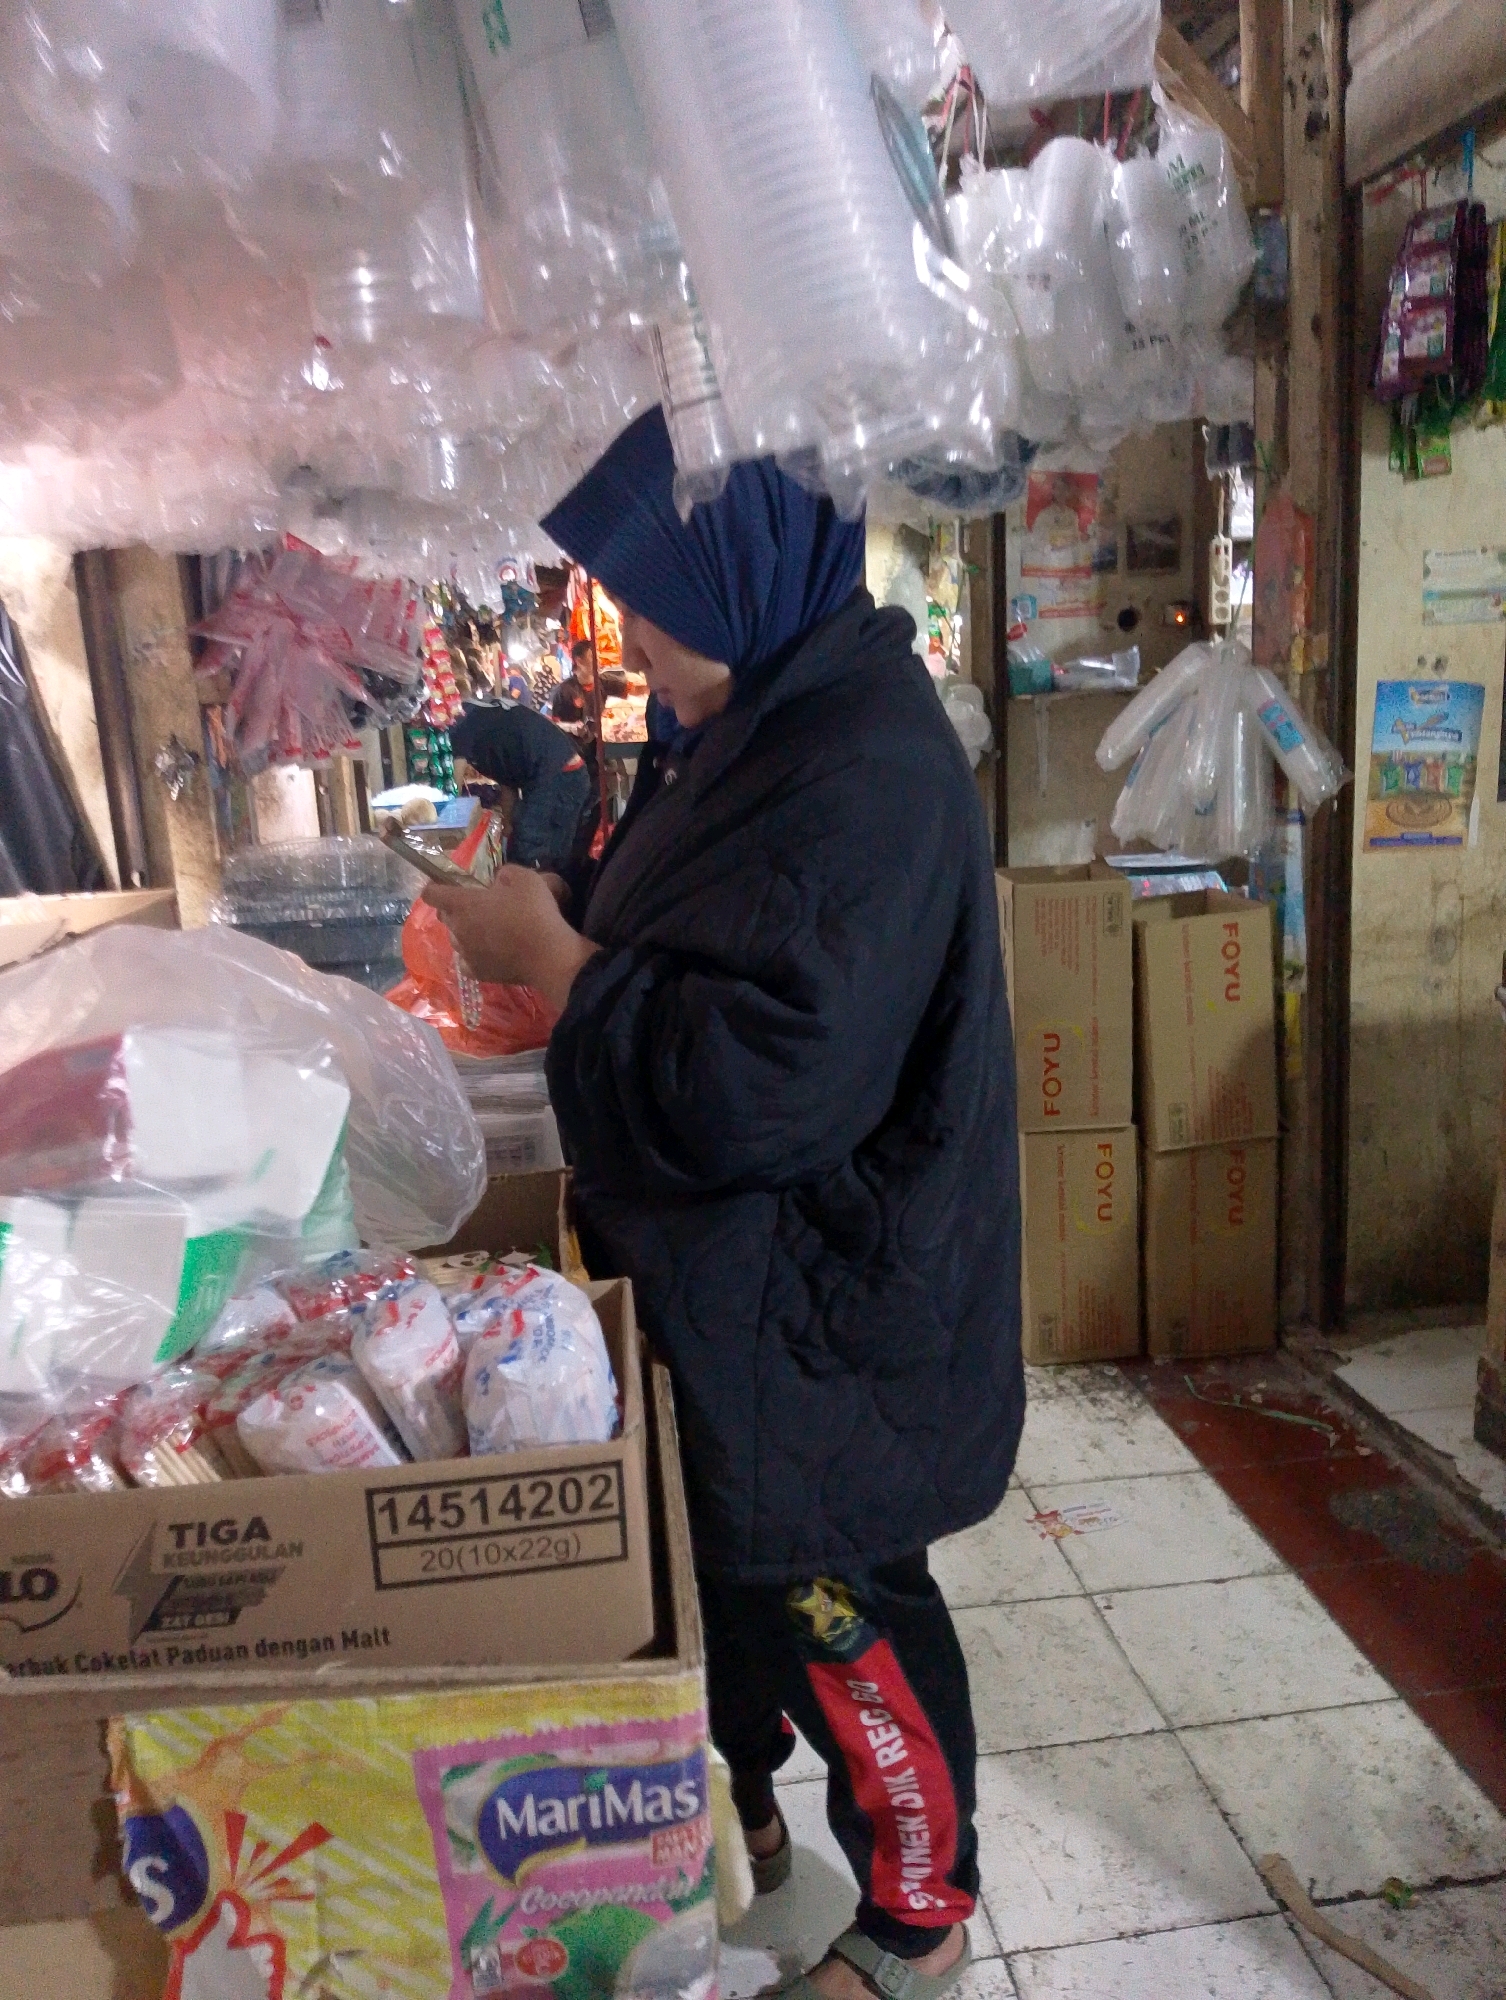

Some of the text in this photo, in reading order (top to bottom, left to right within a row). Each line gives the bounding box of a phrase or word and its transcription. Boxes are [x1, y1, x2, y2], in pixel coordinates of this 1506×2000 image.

[1222, 921, 1242, 1003] FOYU
[1042, 1032, 1062, 1117] FOYU
[1096, 1143, 1115, 1222] FOYU
[1227, 1150, 1246, 1227] FOYU
[168, 1516, 272, 1549] TIGA
[377, 1473, 615, 1536] 14514202
[162, 1541, 304, 1569] KEUNGGULAN
[420, 1532, 582, 1575] 20(10x22g)
[74, 1648, 161, 1674] Cokelat
[166, 1643, 249, 1667] Paduan
[255, 1635, 335, 1660] dengan
[341, 1624, 391, 1649] Malt
[859, 1707, 909, 1770] REG
[496, 1770, 701, 1841] MariMas
[883, 1766, 926, 1810] DIK
